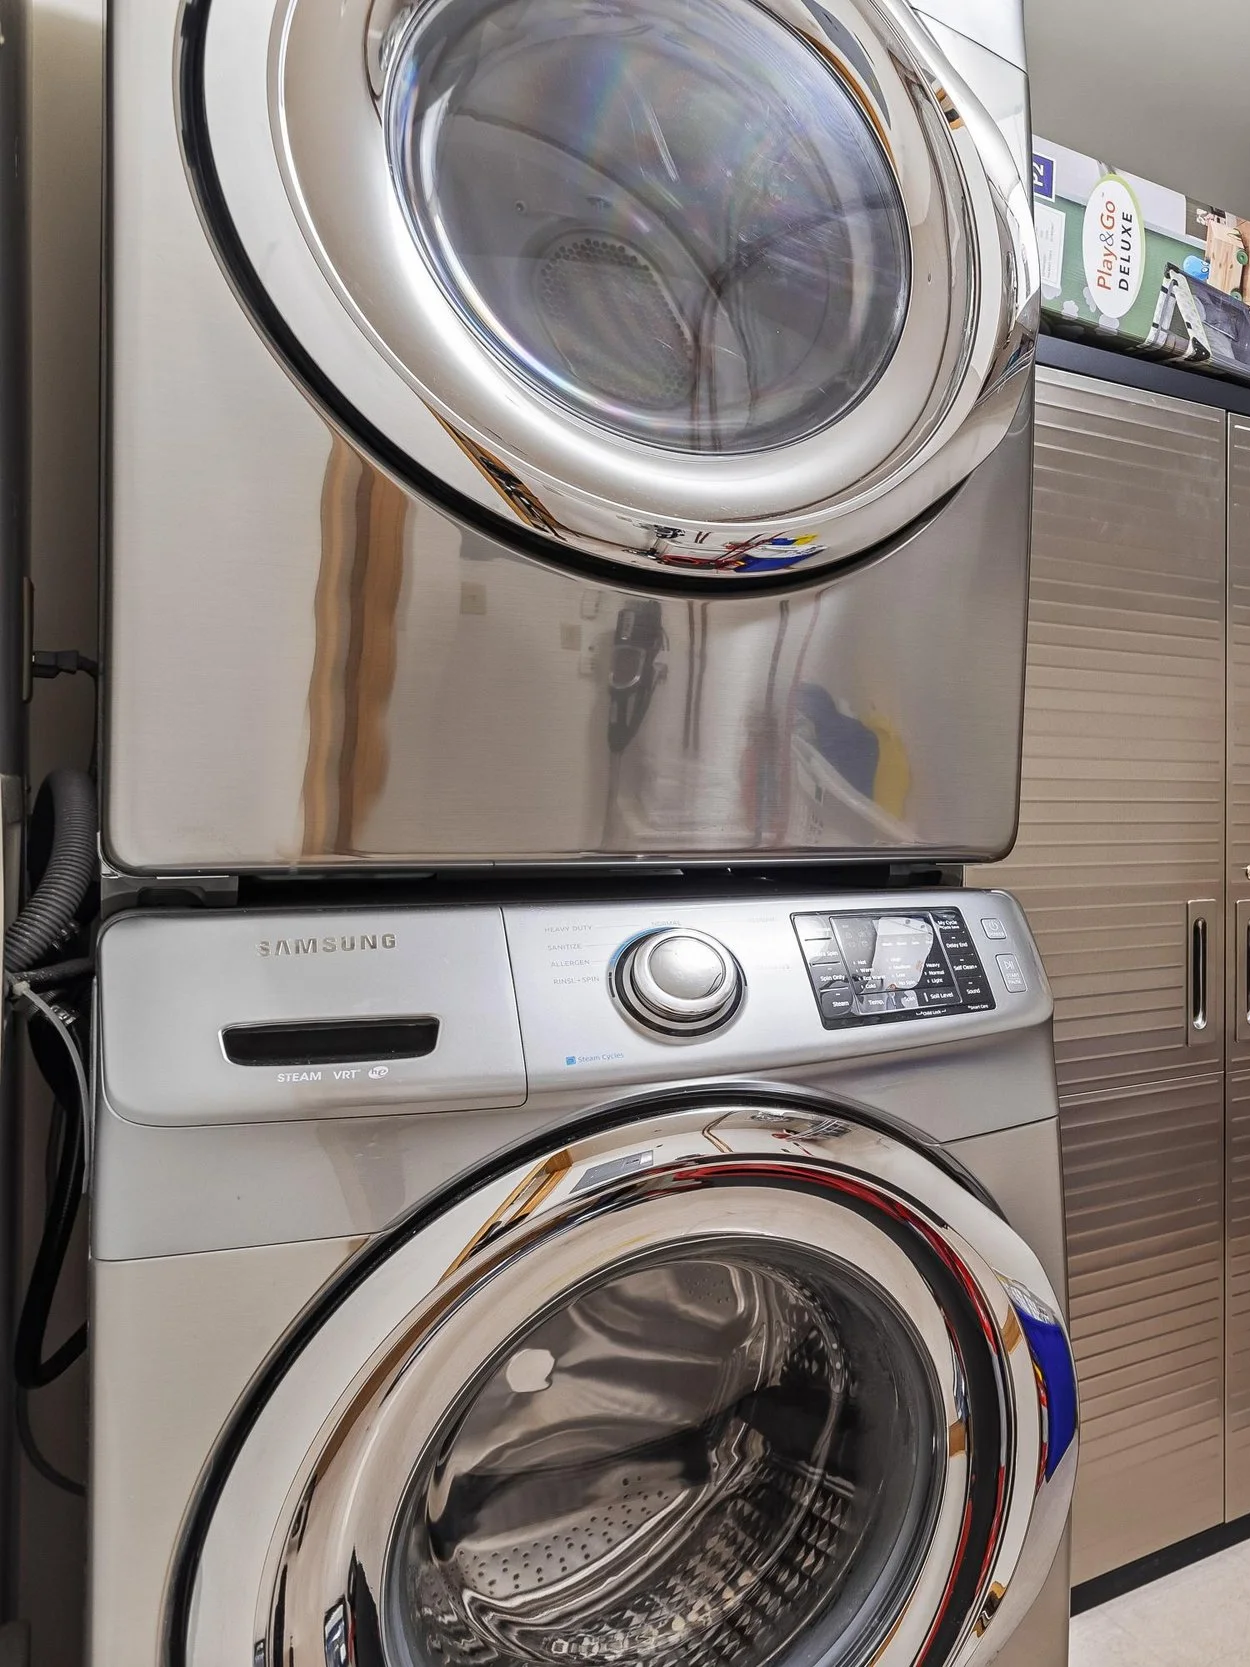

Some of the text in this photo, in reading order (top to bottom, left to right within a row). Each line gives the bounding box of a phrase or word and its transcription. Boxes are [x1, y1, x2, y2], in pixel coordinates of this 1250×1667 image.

[1096, 200, 1118, 290] Play&Go
[1118, 212, 1133, 292] DELUXE
[257, 933, 397, 957] SAMSUNG
[551, 960, 590, 968] ALLERGEN
[277, 1071, 322, 1082] STEAM
[333, 1069, 357, 1080] VRT
